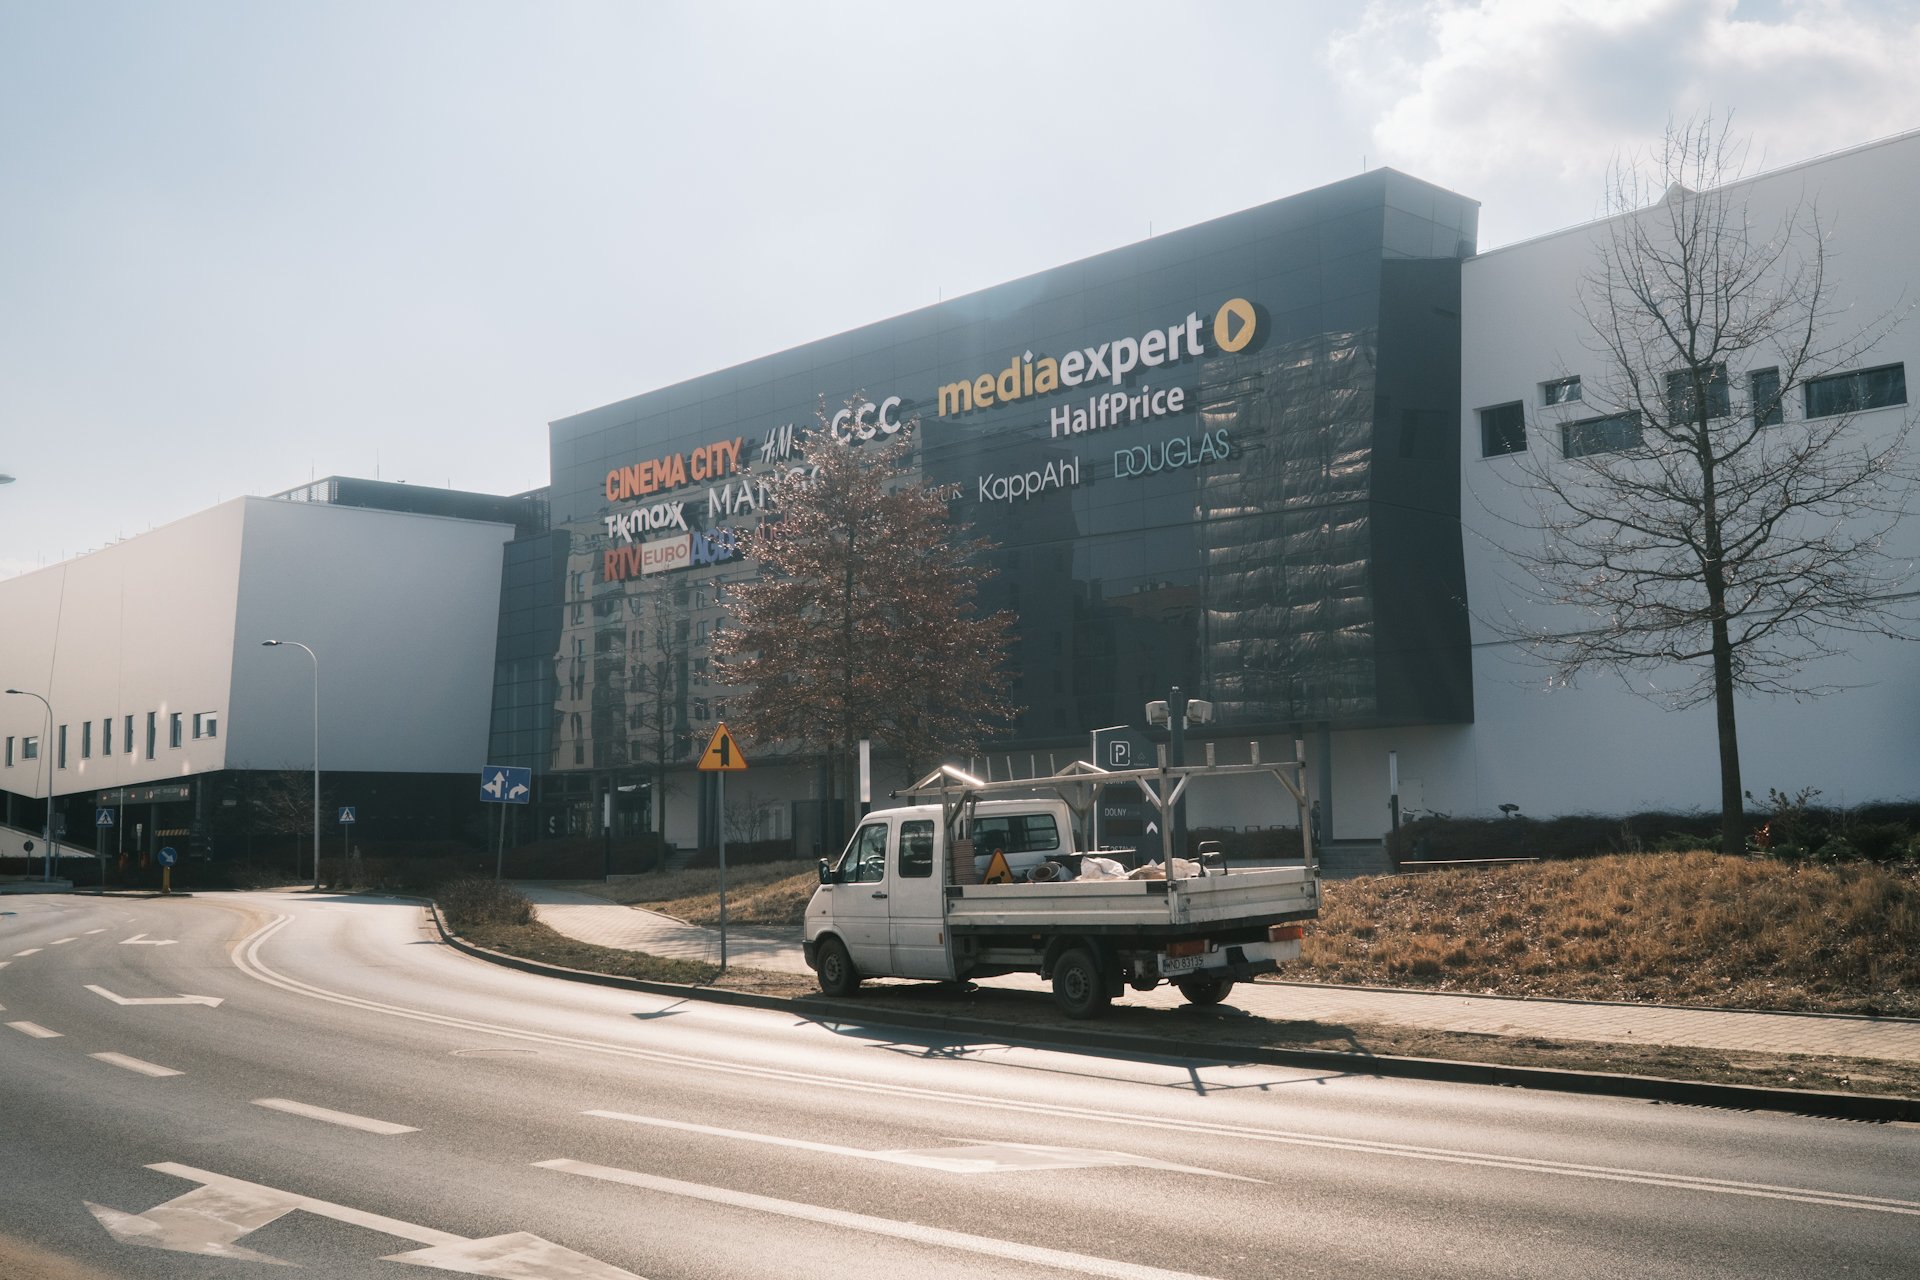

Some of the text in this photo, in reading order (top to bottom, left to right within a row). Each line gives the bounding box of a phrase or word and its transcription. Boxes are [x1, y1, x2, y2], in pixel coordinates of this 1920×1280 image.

[831, 396, 901, 443] CCC
[1051, 385, 1185, 438] HalfPrice
[605, 436, 743, 501] CINEMA CITY
[760, 423, 794, 464] H&M
[1114, 428, 1230, 478] DOUGLAS
[708, 464, 824, 518] MANG
[979, 456, 1079, 503] KappAhl
[604, 528, 735, 582] RTV EURO AGD
